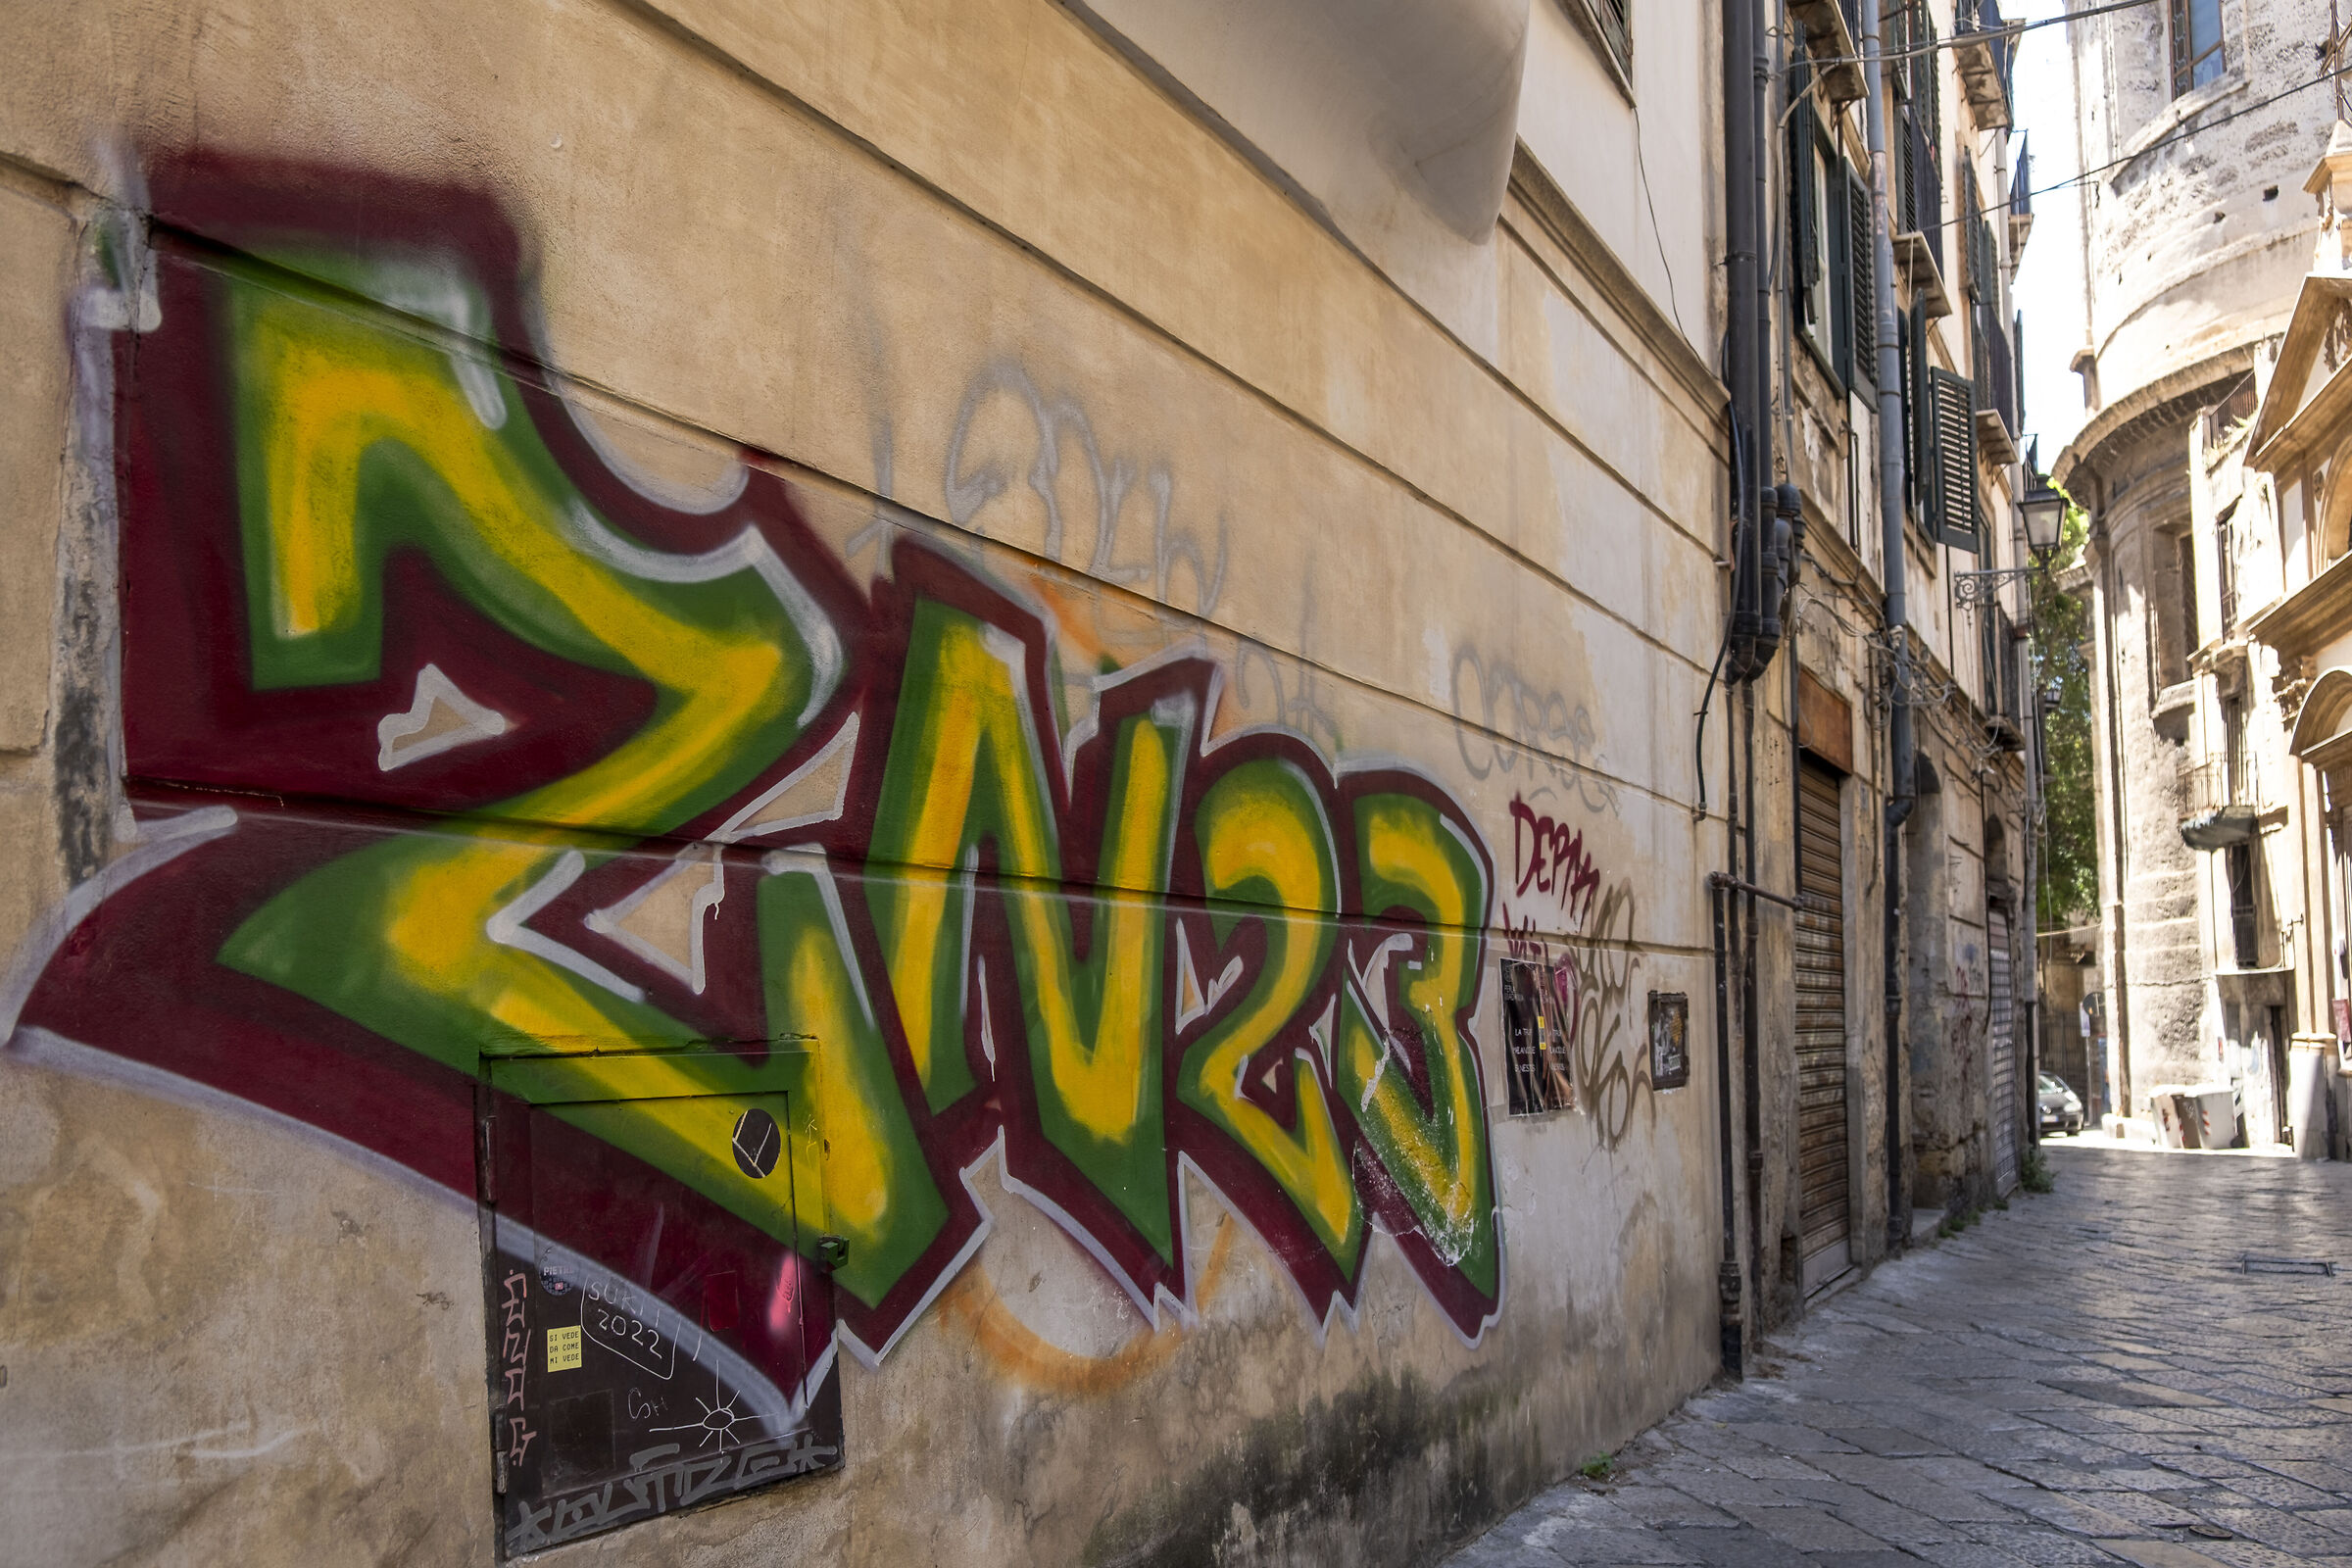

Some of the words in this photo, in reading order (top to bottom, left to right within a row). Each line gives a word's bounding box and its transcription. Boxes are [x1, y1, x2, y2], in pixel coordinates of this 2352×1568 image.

[549, 1334, 558, 1343] SI
[562, 1331, 579, 1340] VEDE
[597, 1308, 662, 1360] 2022
[563, 1343, 579, 1351] COME
[550, 1356, 558, 1365] MI
[563, 1352, 580, 1361] VEDE
